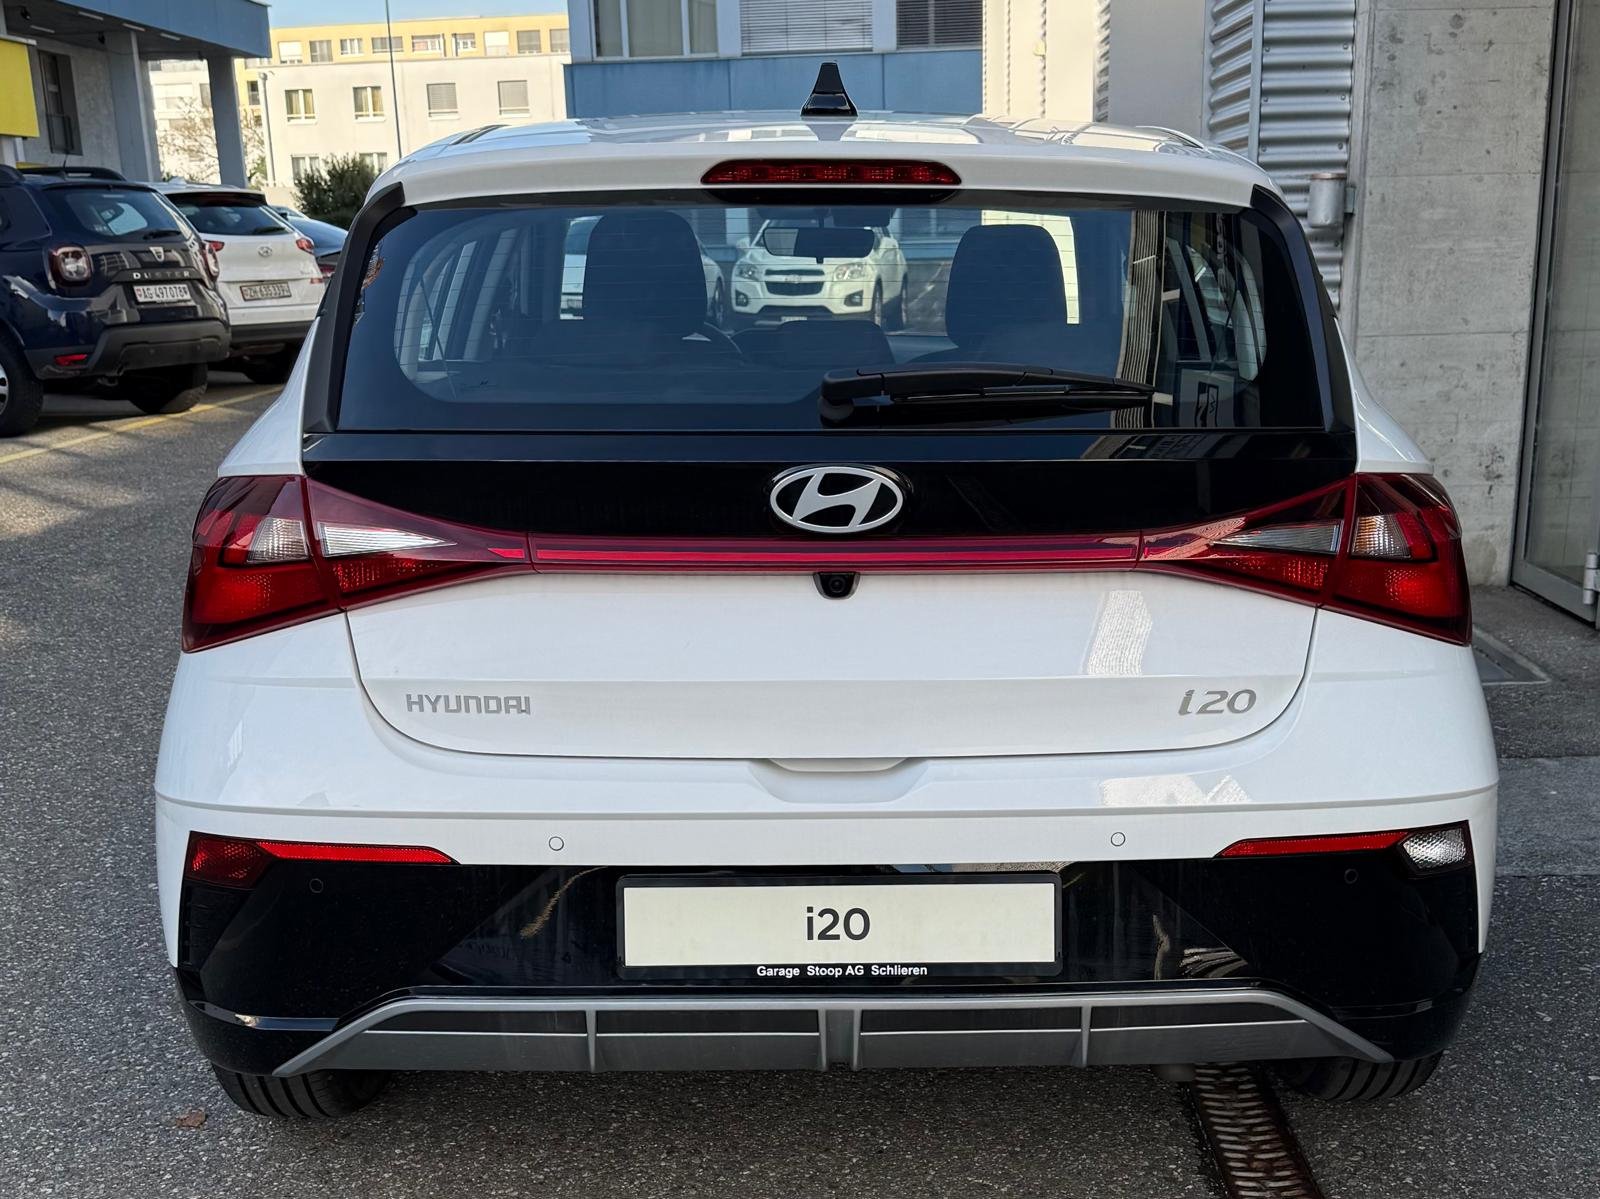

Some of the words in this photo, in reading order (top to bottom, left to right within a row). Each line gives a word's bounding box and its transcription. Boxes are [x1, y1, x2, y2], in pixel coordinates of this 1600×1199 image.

[132, 270, 190, 279] DUSTER
[406, 694, 531, 715] HYUNDAI
[1178, 689, 1257, 716] i20
[806, 906, 871, 941] i20
[756, 966, 800, 979] Garage
[806, 965, 842, 978] Stoop
[845, 965, 865, 976] AG
[871, 965, 928, 976] Schlieren
